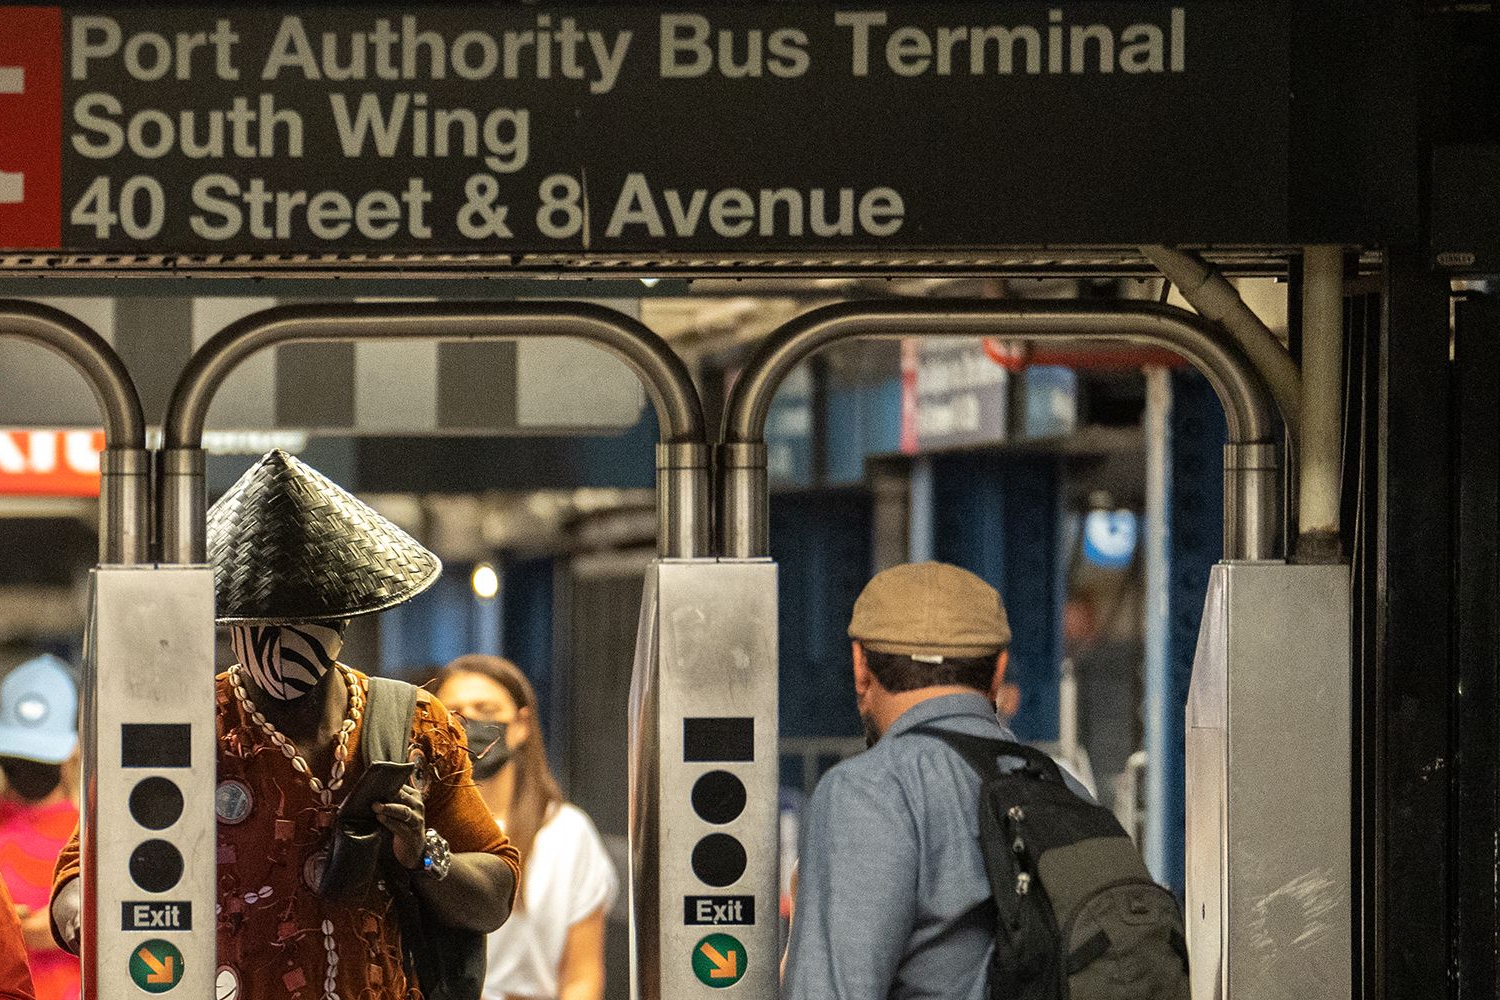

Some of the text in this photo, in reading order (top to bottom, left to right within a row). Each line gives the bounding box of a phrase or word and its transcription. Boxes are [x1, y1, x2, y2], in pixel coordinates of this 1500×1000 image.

[71, 8, 1185, 94] Port Authority Bus Terminal
[71, 92, 532, 173] South Wing
[70, 173, 905, 241] 40 Street & 8 Avenue
[133, 905, 180, 926] Exit
[696, 900, 743, 922] Exit
